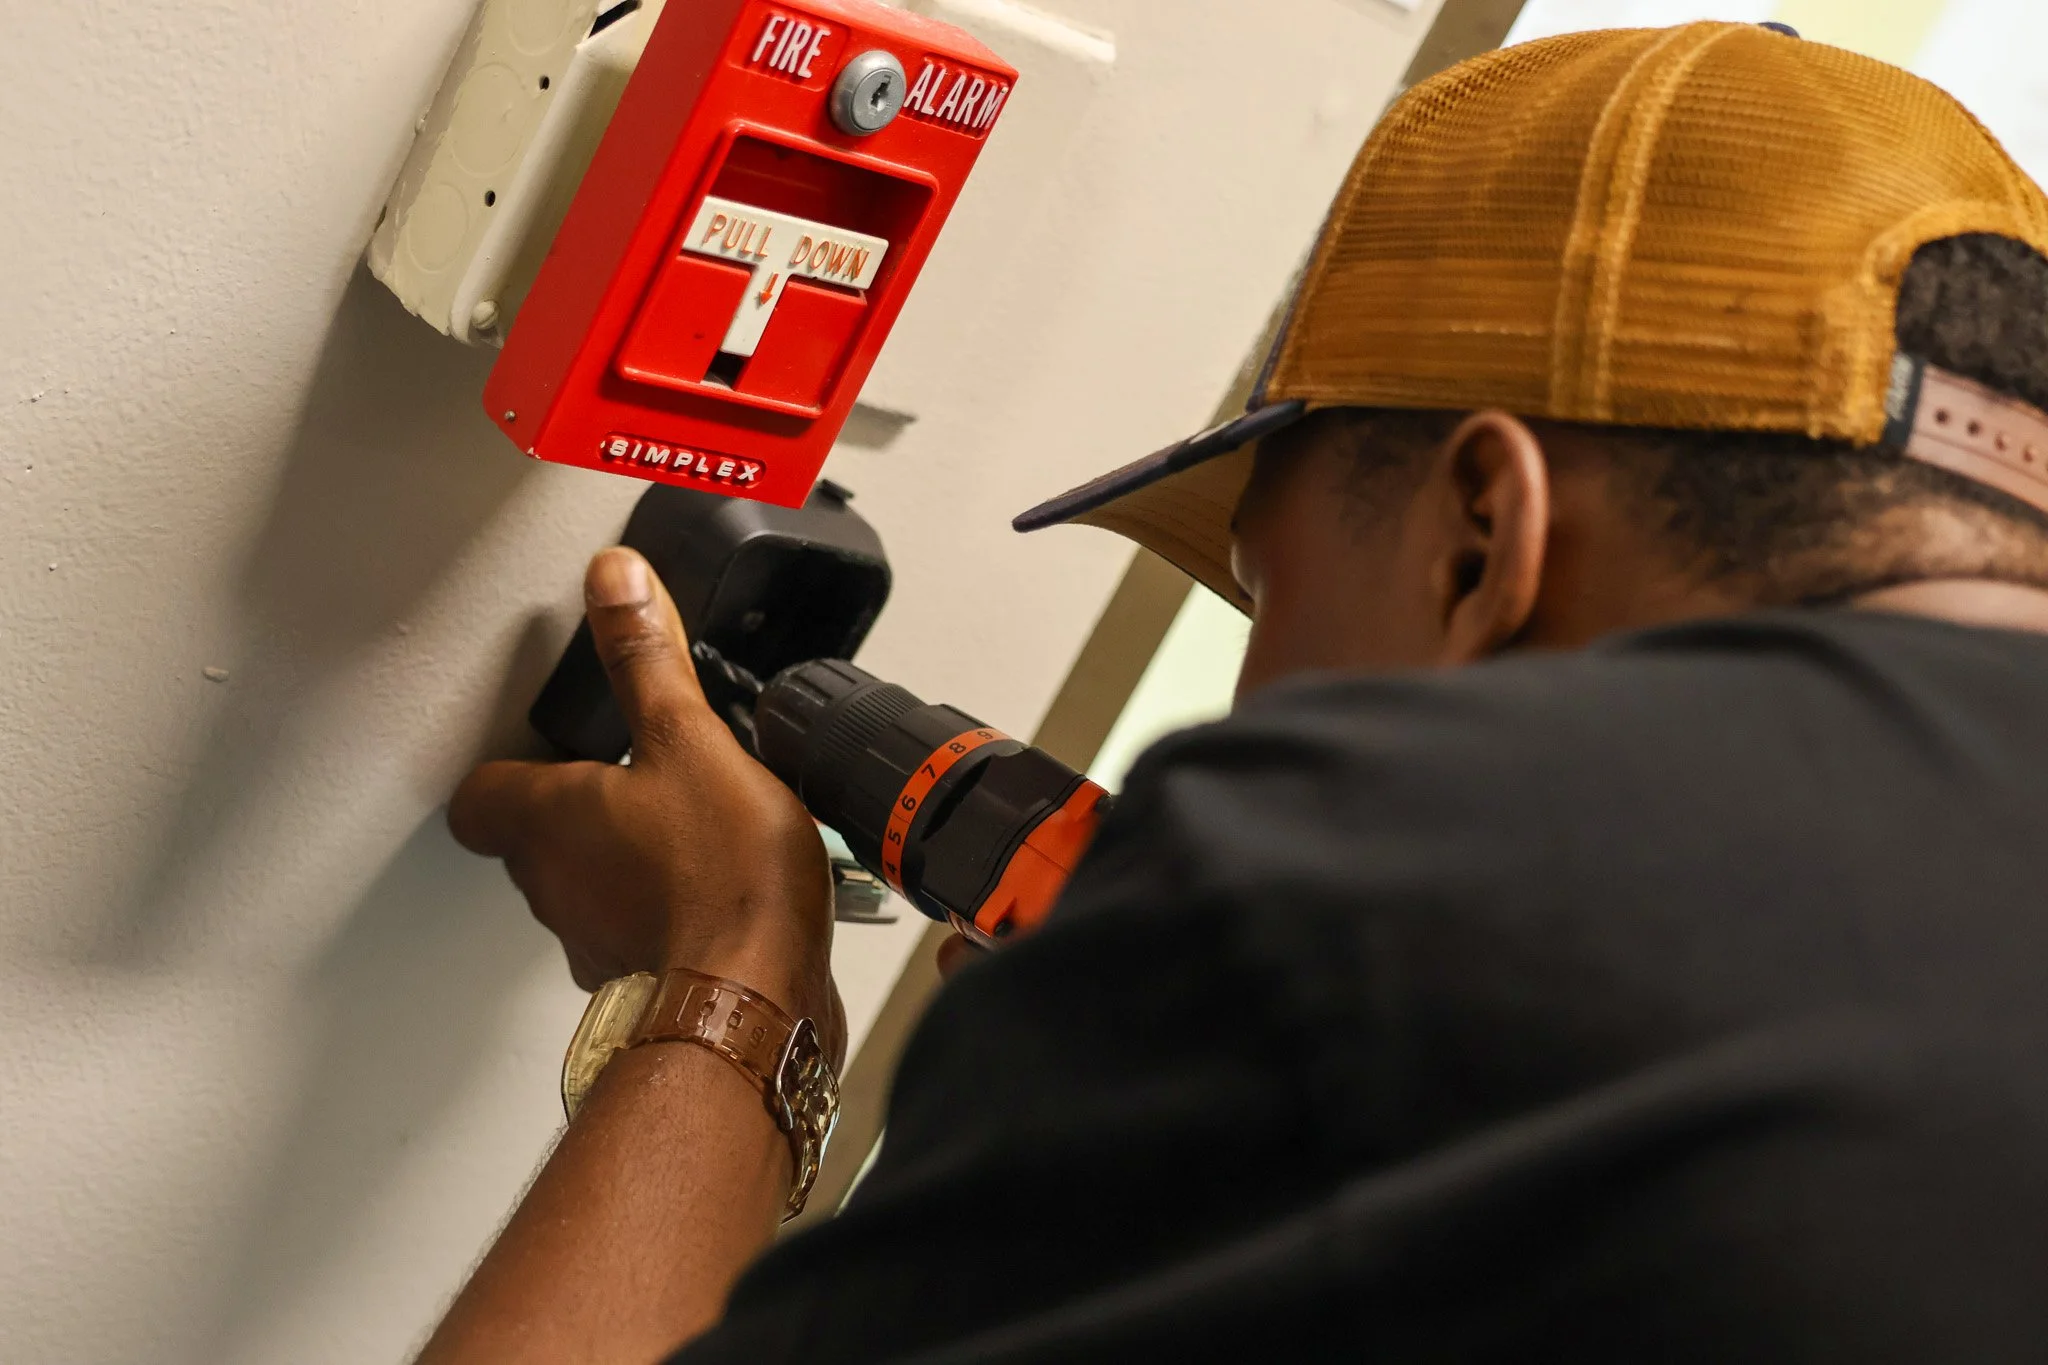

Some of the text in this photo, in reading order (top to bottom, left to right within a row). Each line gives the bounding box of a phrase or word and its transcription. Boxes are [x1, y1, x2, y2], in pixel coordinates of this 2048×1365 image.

[752, 15, 1008, 130] FIRE ALARM
[702, 213, 870, 280] PULL DOWN
[609, 439, 760, 481] SIMPLEX
[885, 731, 993, 875] 4 5 6 7 8 9
